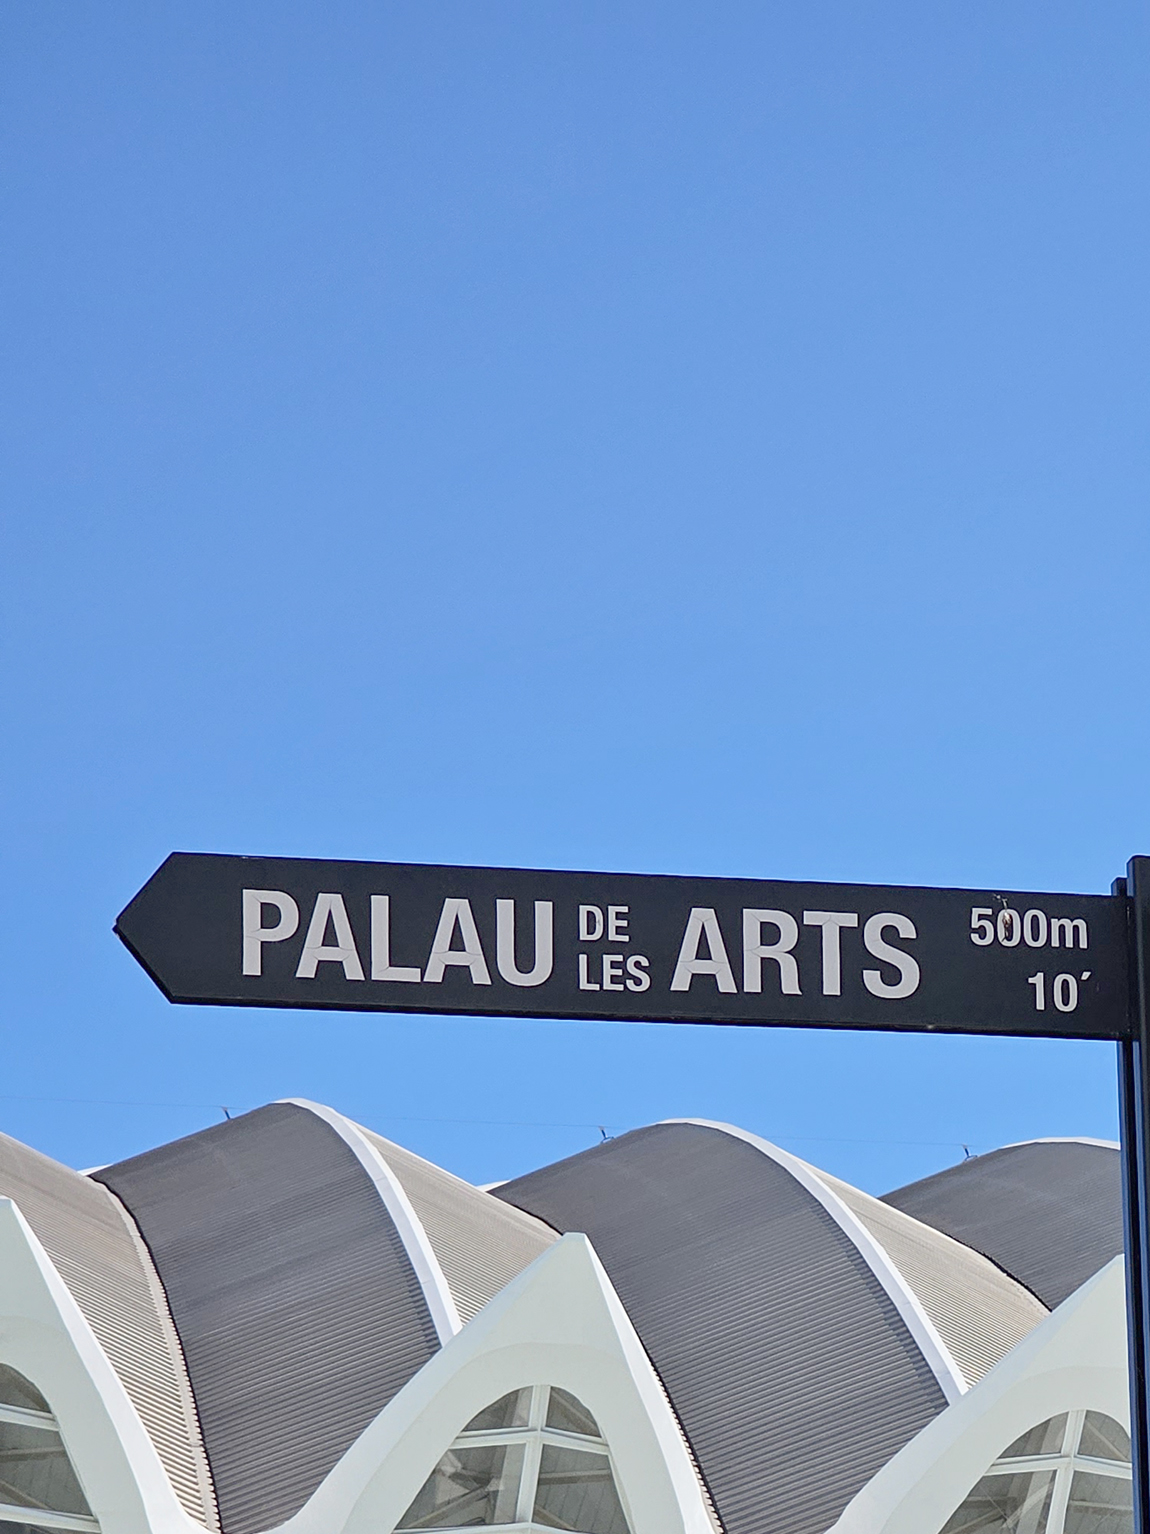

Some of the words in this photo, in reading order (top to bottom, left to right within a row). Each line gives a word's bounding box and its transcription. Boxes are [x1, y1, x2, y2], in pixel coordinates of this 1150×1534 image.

[243, 889, 552, 986] PALAU
[580, 905, 629, 941] DE
[970, 907, 1088, 949] 500m
[579, 954, 650, 991] LES
[670, 908, 919, 998] ARTS
